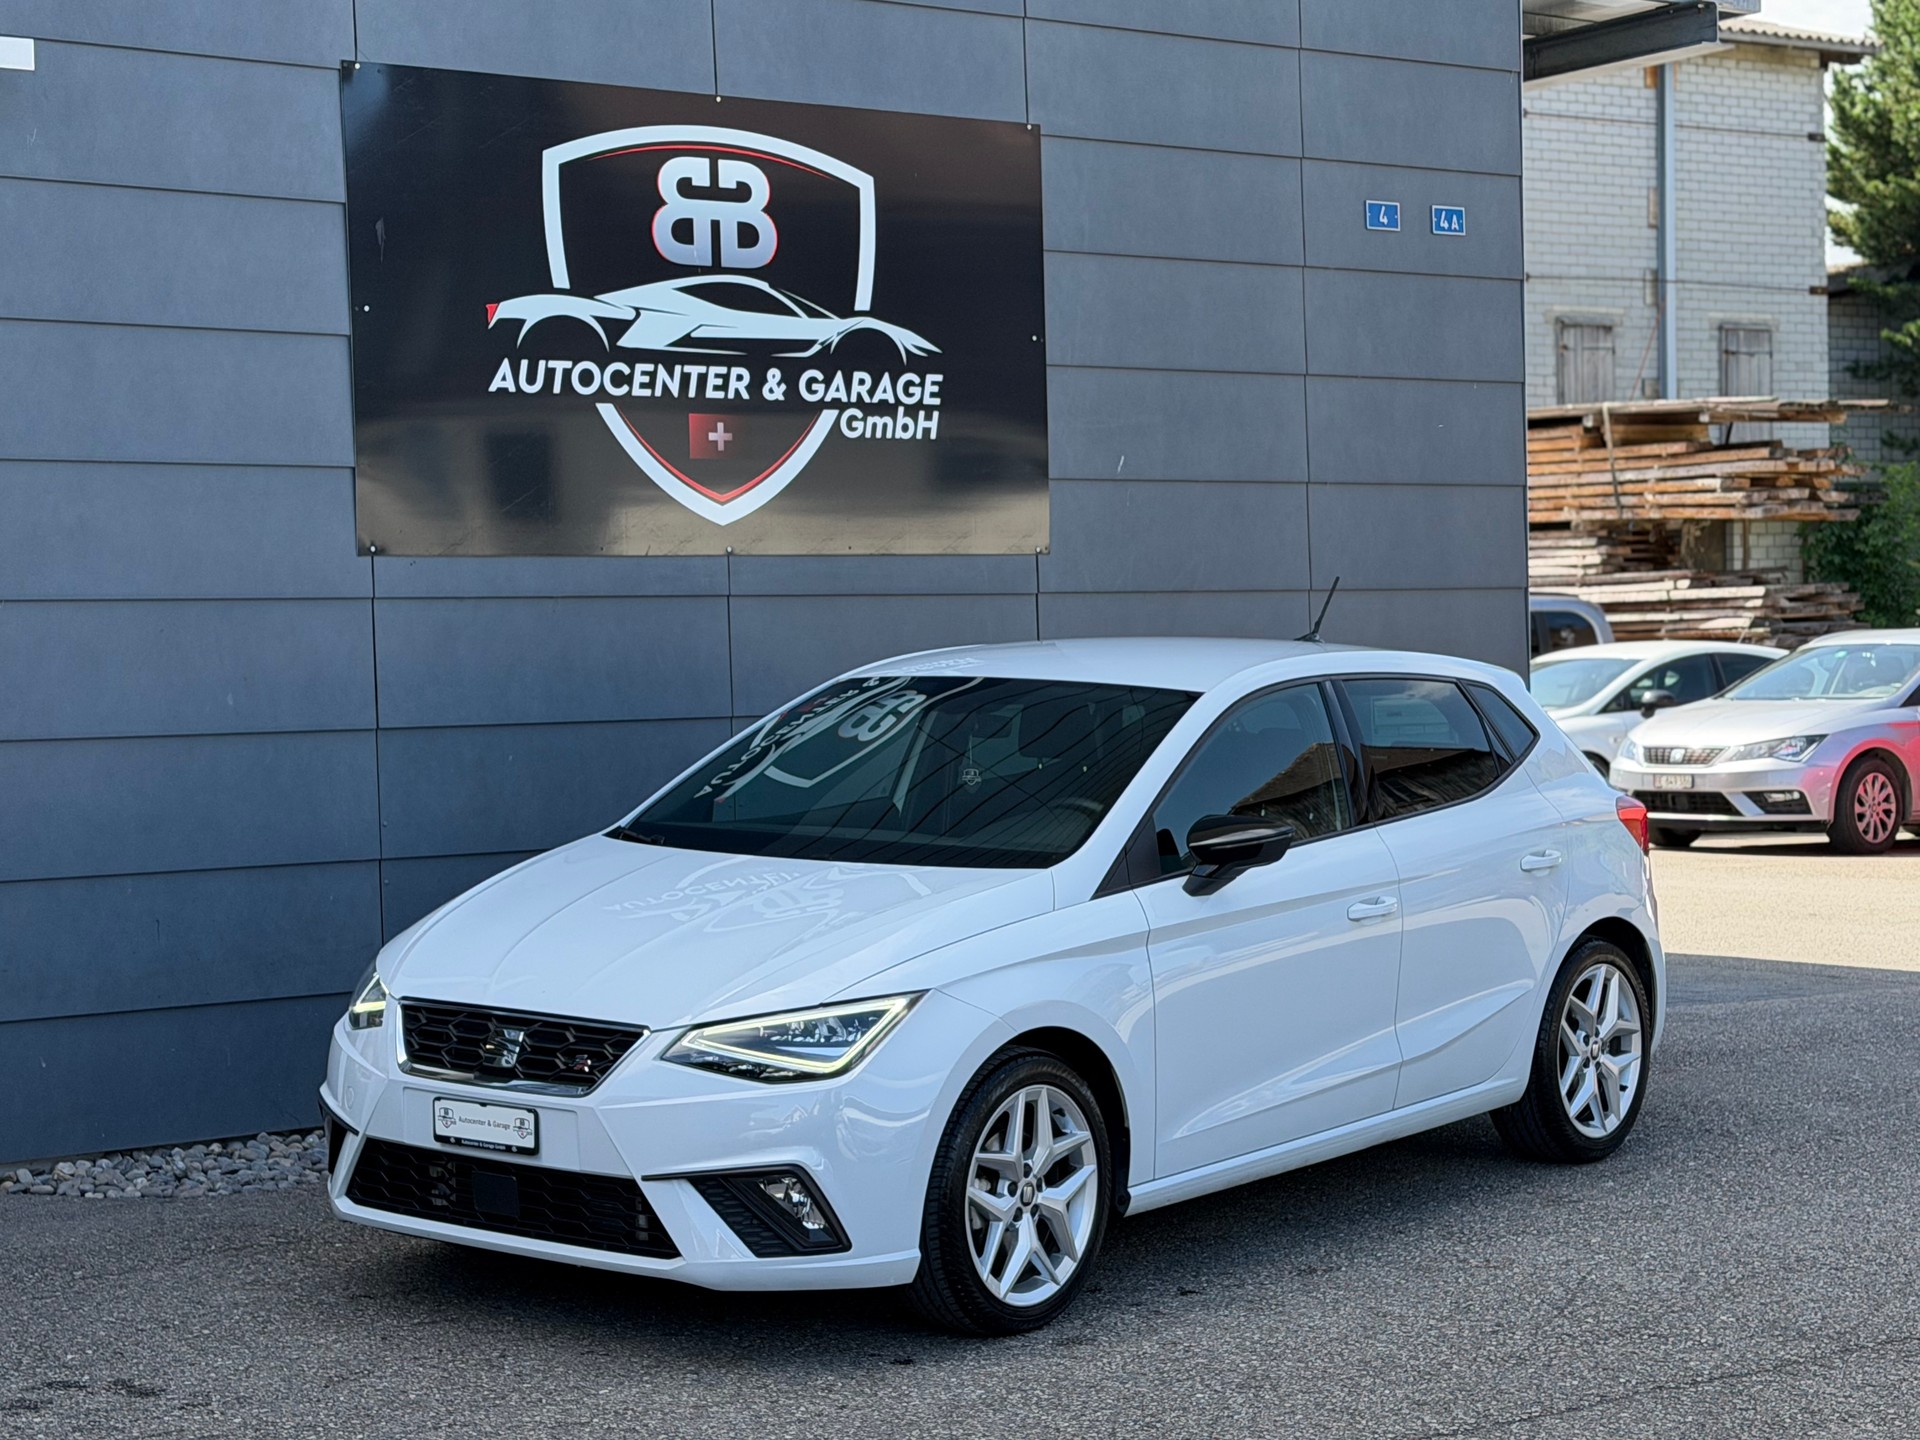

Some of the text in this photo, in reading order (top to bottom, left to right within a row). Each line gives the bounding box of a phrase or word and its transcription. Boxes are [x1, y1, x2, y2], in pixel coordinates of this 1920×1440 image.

[1379, 205, 1388, 225] 4
[1440, 210, 1459, 231] 4A
[488, 357, 944, 406] AUTOCENTER & GARAGE
[840, 407, 940, 440] GmbH
[458, 1116, 486, 1126] Autocenter
[493, 1120, 511, 1131] Garage
